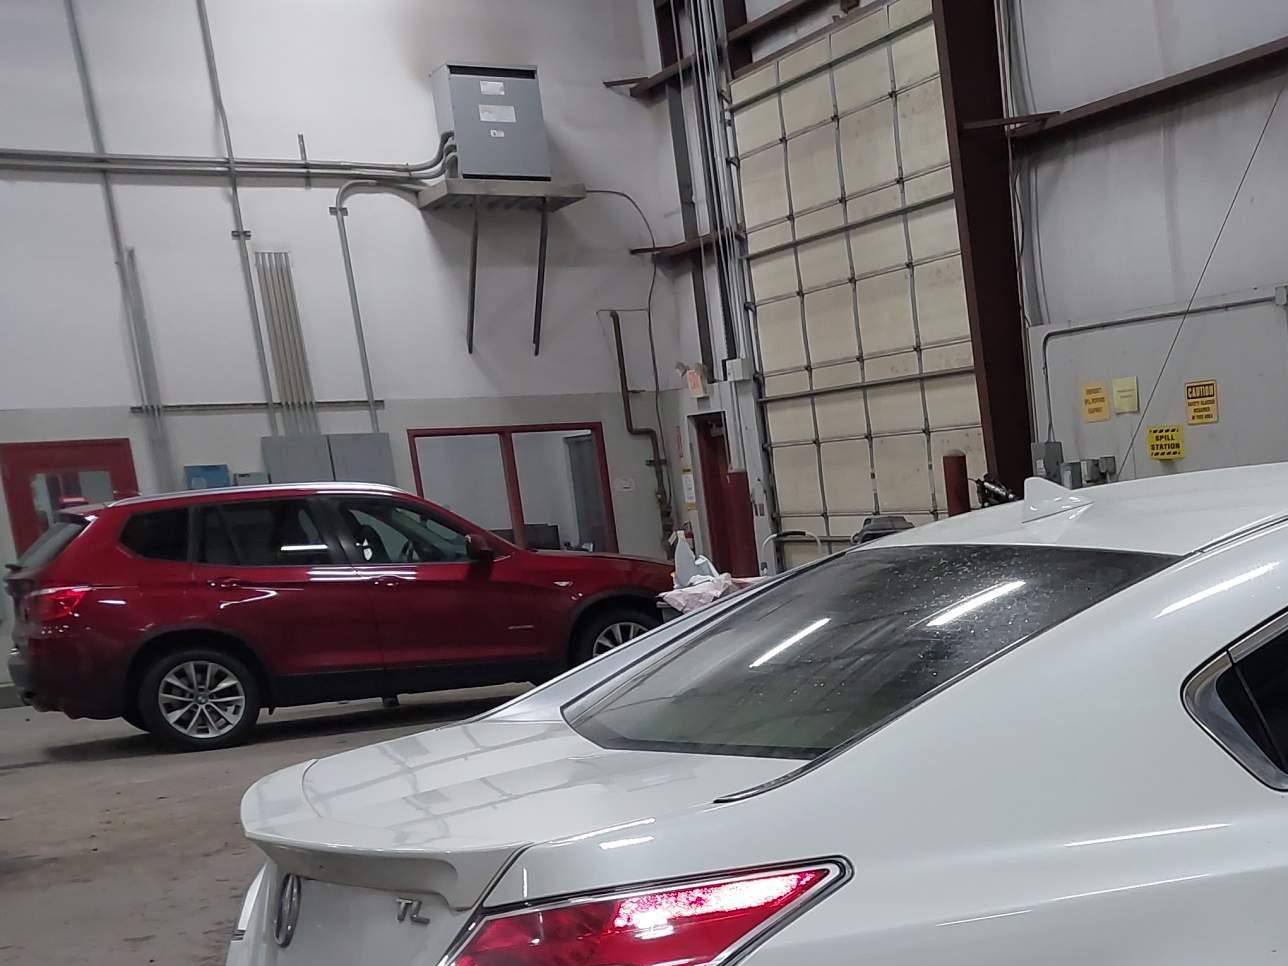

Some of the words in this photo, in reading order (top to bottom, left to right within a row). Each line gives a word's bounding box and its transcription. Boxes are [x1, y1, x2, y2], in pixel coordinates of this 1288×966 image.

[1187, 384, 1214, 398] CAUTION
[1155, 433, 1175, 441] SPILL
[1150, 442, 1181, 451] STATION
[396, 898, 430, 926] TL
